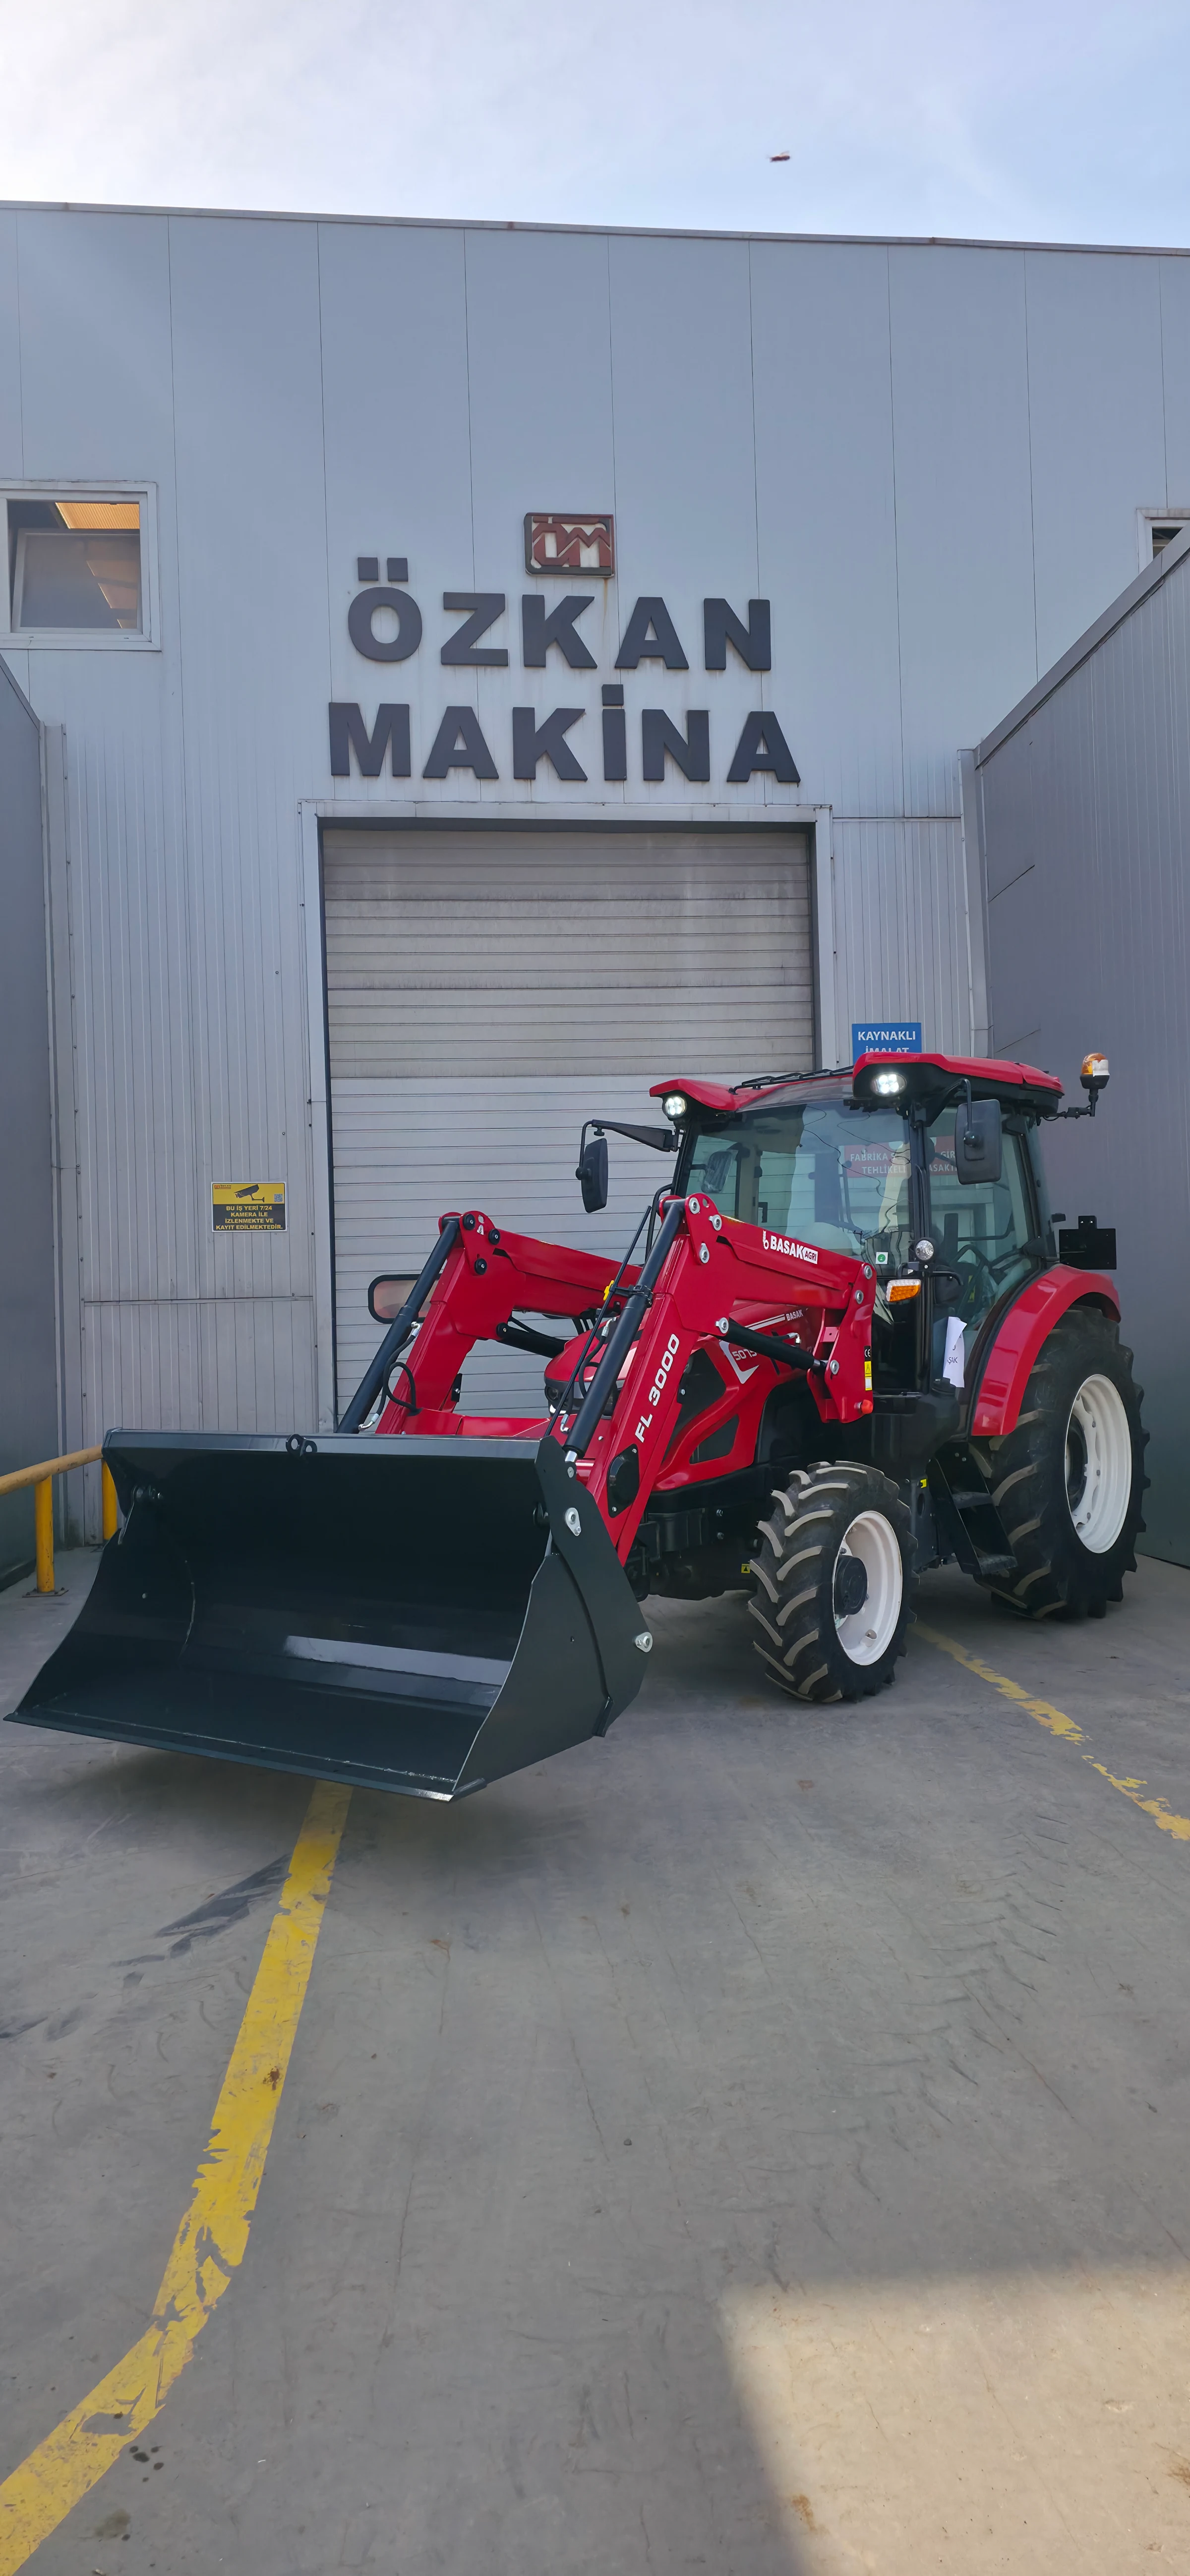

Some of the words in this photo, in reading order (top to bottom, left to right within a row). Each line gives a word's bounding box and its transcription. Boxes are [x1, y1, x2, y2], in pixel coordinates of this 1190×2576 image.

[348, 557, 772, 671] ÖZKAN
[328, 684, 801, 782] MAKİNA
[858, 1031, 916, 1040] KAYNAKLI
[850, 1151, 888, 1161] FABRİKA
[770, 1235, 804, 1259] BASAK
[804, 1250, 817, 1261] AGRI
[786, 1310, 804, 1321] BASAK
[732, 1349, 758, 1361] 5075
[635, 1414, 653, 1443] FL
[649, 1333, 680, 1406] 3000
